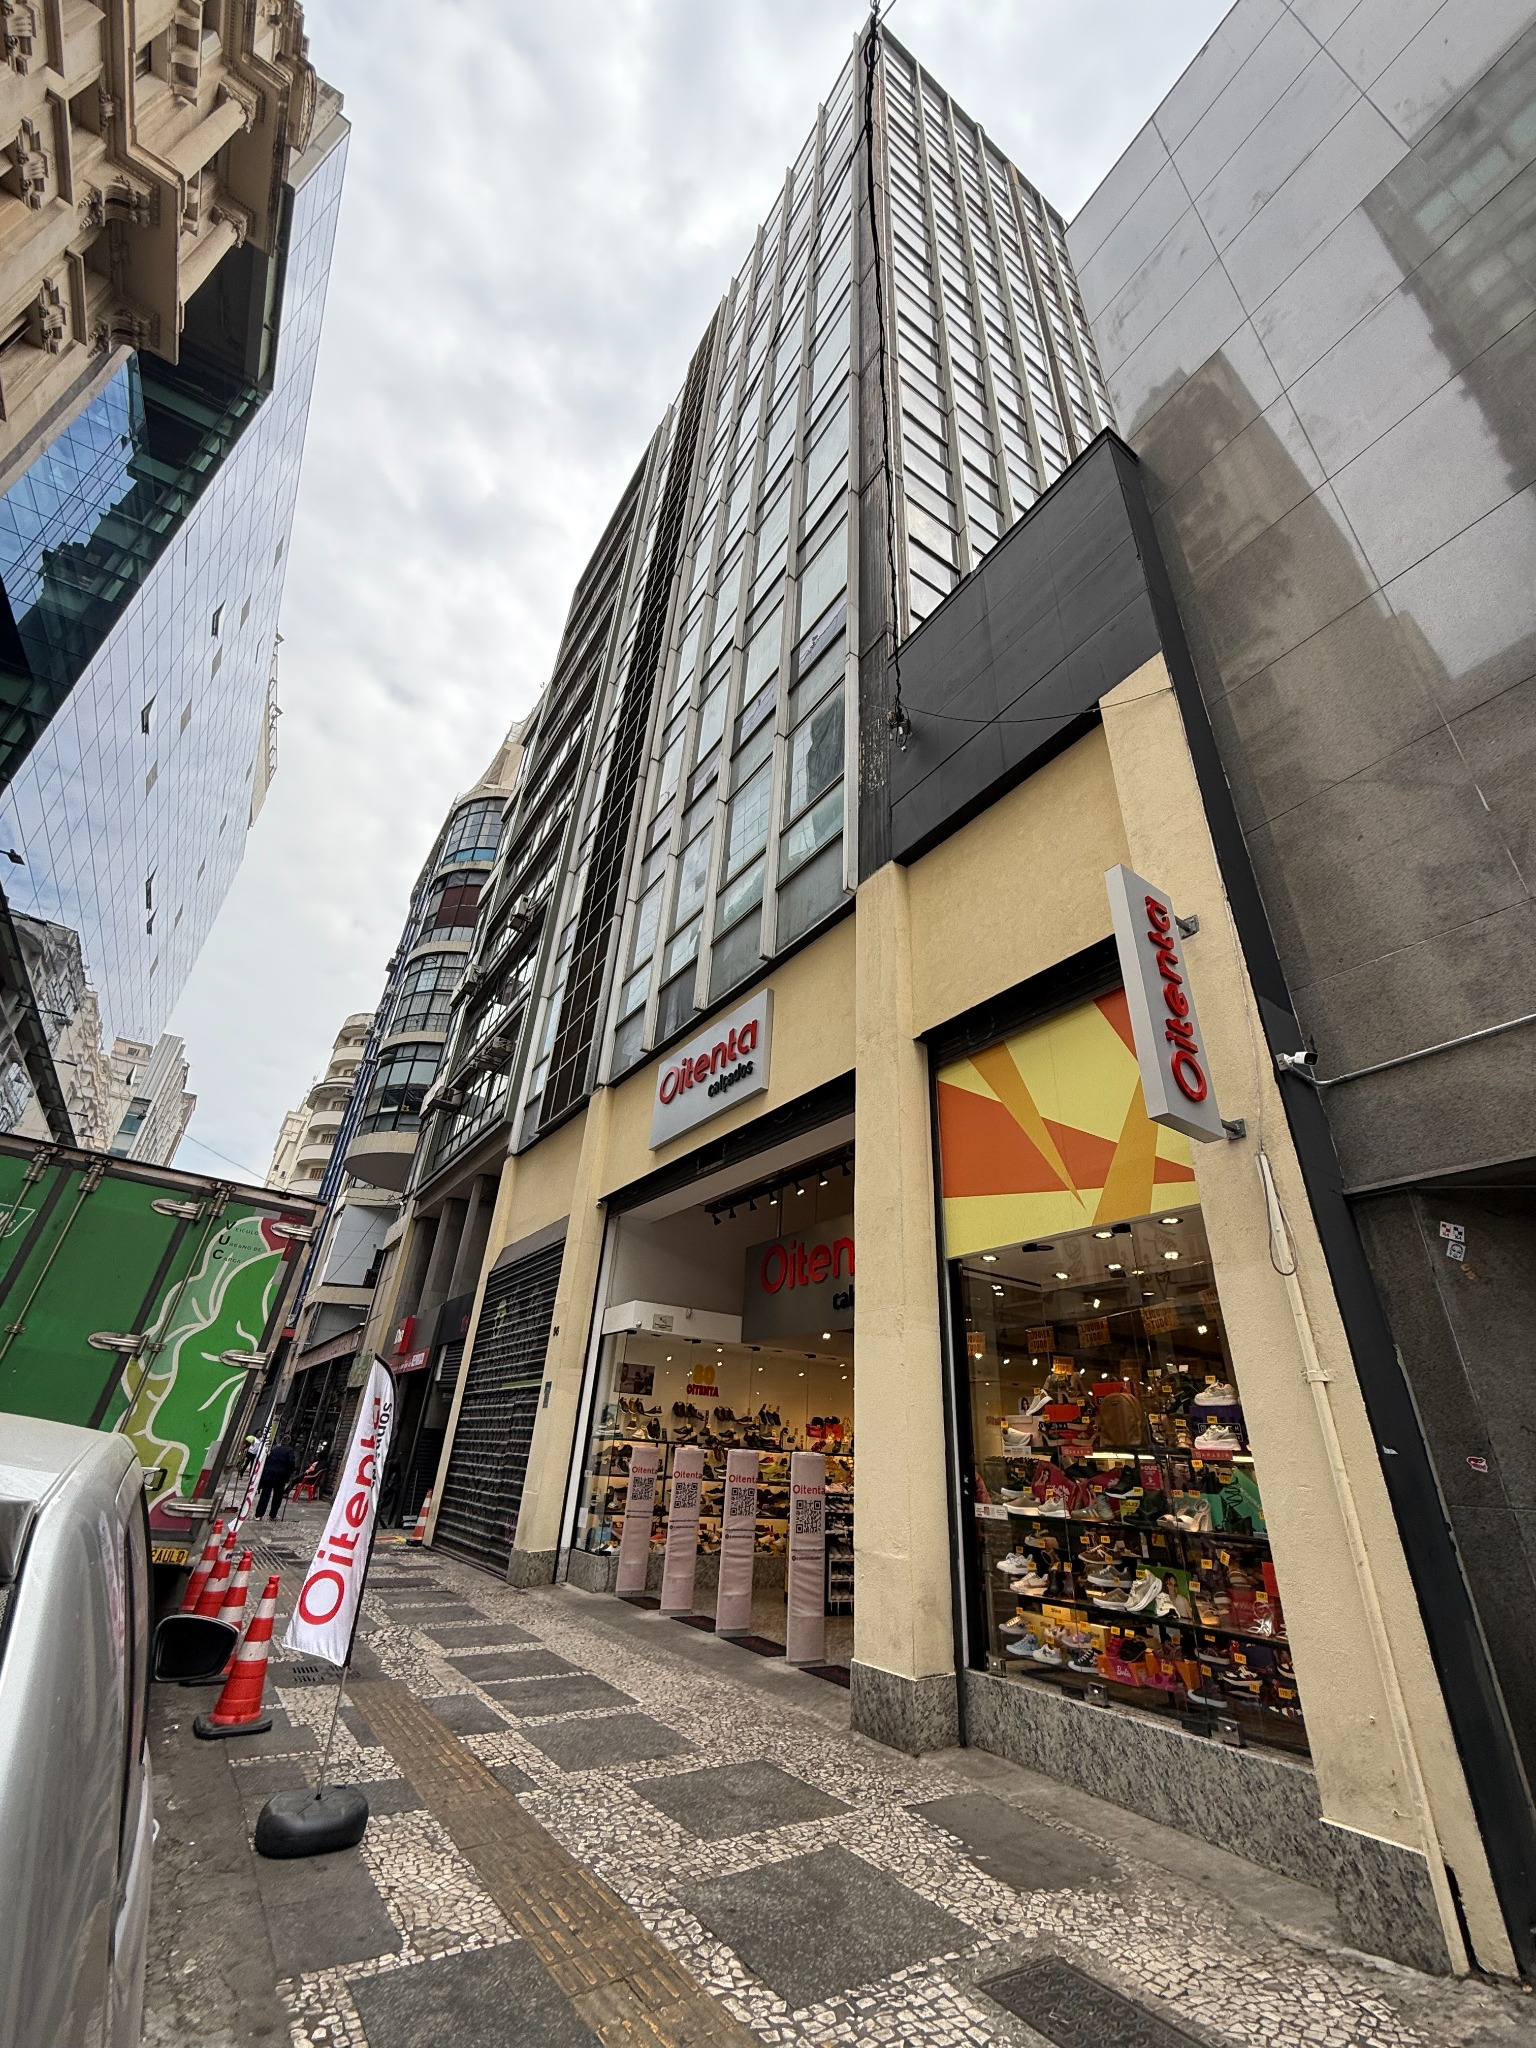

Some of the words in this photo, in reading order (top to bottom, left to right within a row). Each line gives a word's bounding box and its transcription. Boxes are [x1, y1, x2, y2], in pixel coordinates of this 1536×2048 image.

[1144, 895, 1208, 1103] Oitenta
[659, 1018, 758, 1104] Oitenta
[707, 1060, 754, 1098] calçados
[760, 1236, 855, 1295] Oiten
[692, 1363, 716, 1386] 80
